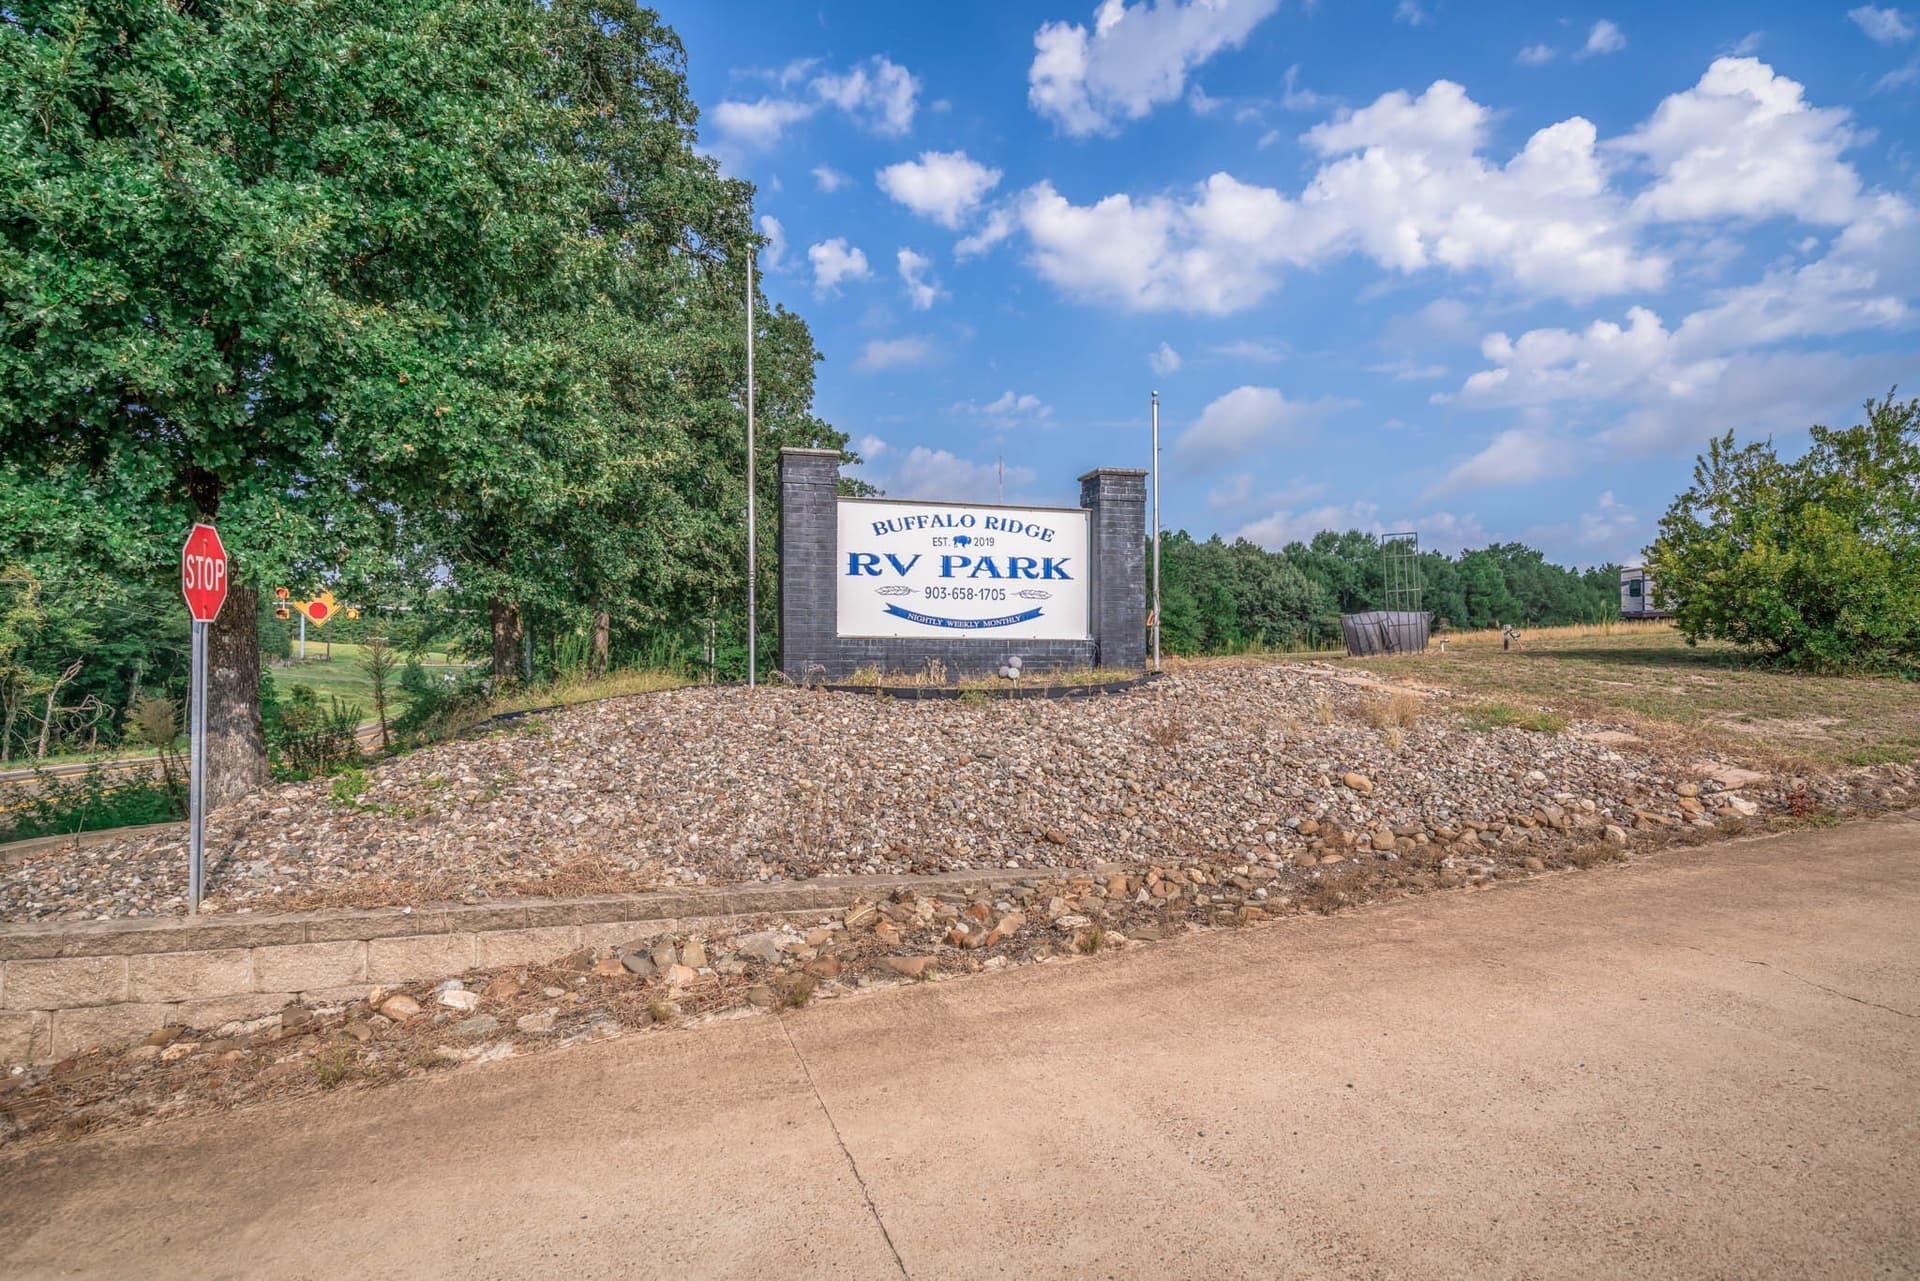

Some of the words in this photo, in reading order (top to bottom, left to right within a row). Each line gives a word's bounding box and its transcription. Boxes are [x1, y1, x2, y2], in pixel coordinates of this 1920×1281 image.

[872, 513, 976, 536] BUFFALO
[985, 515, 1056, 543] RIDGE
[932, 537, 951, 547] EST.
[974, 536, 995, 547] 2019
[185, 554, 225, 592] STOP
[845, 552, 923, 577] RV
[938, 554, 1074, 580] PARK
[924, 586, 1007, 601] 903-658-1705
[907, 612, 943, 626] NIGHTLY
[947, 619, 980, 629] WEEKLY
[982, 615, 1022, 629] MONTHLY
